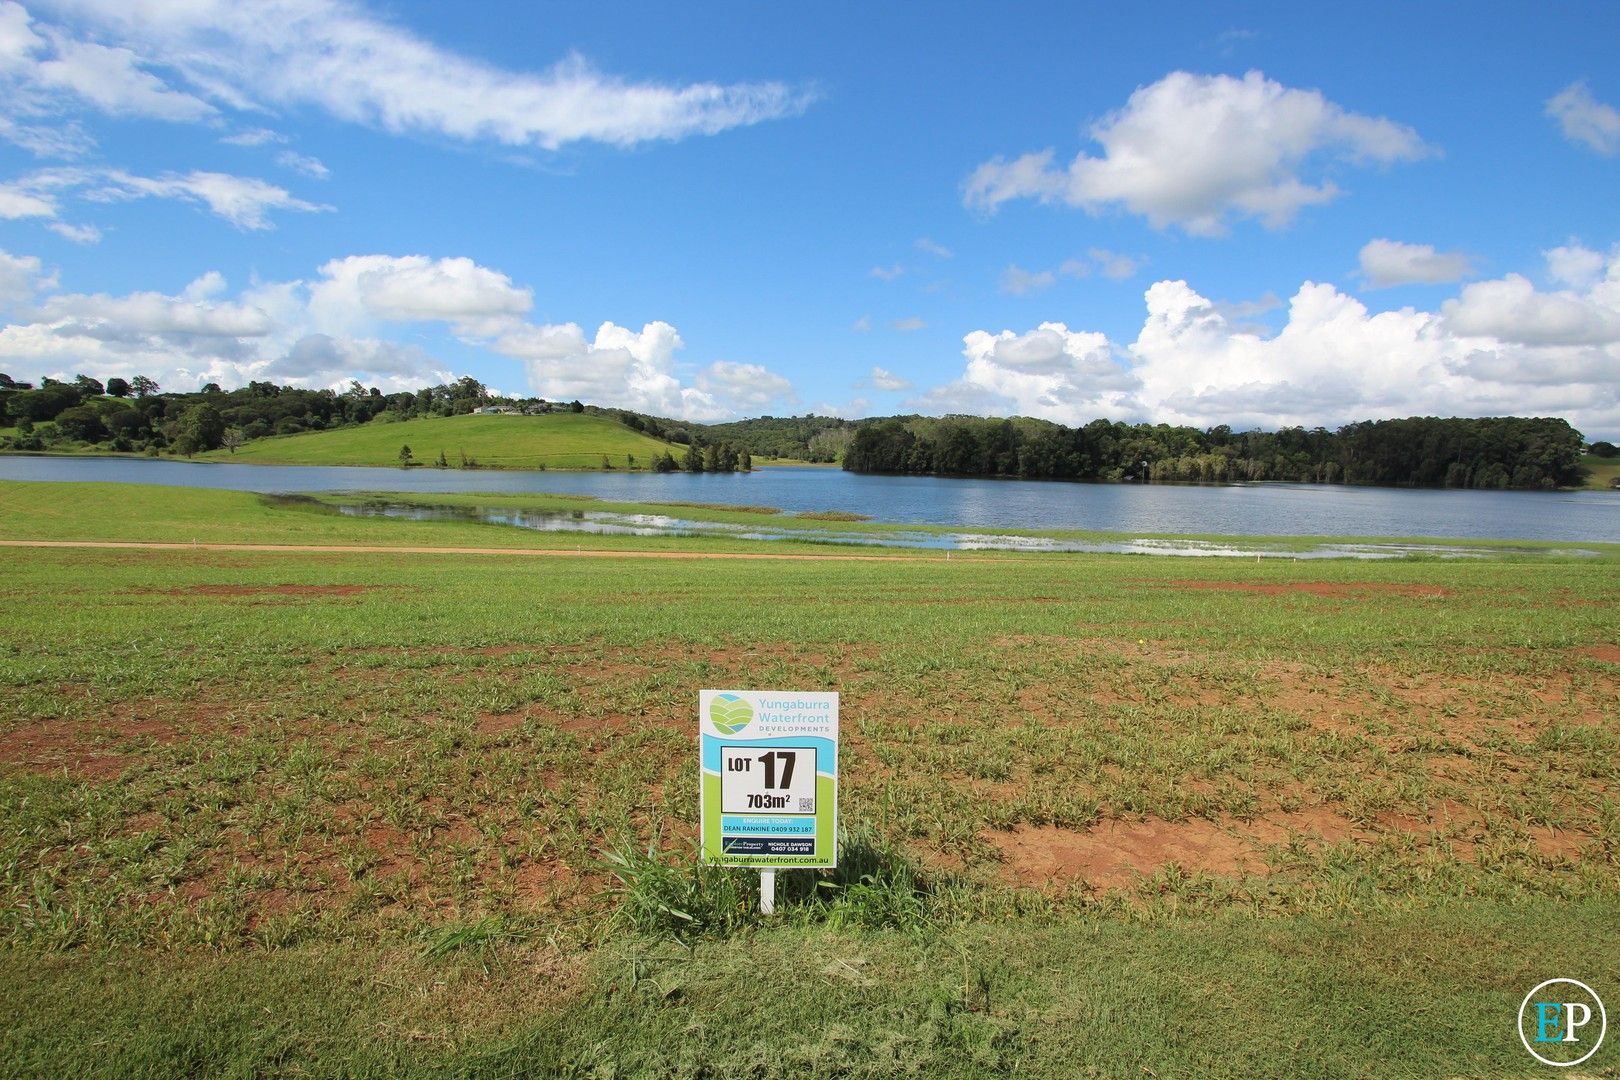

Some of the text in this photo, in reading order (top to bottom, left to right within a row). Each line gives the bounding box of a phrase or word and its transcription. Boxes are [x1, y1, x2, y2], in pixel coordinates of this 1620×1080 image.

[759, 699, 830, 711] Yungaburra
[759, 713, 829, 723] Waterfront
[728, 751, 796, 790] LOT 17
